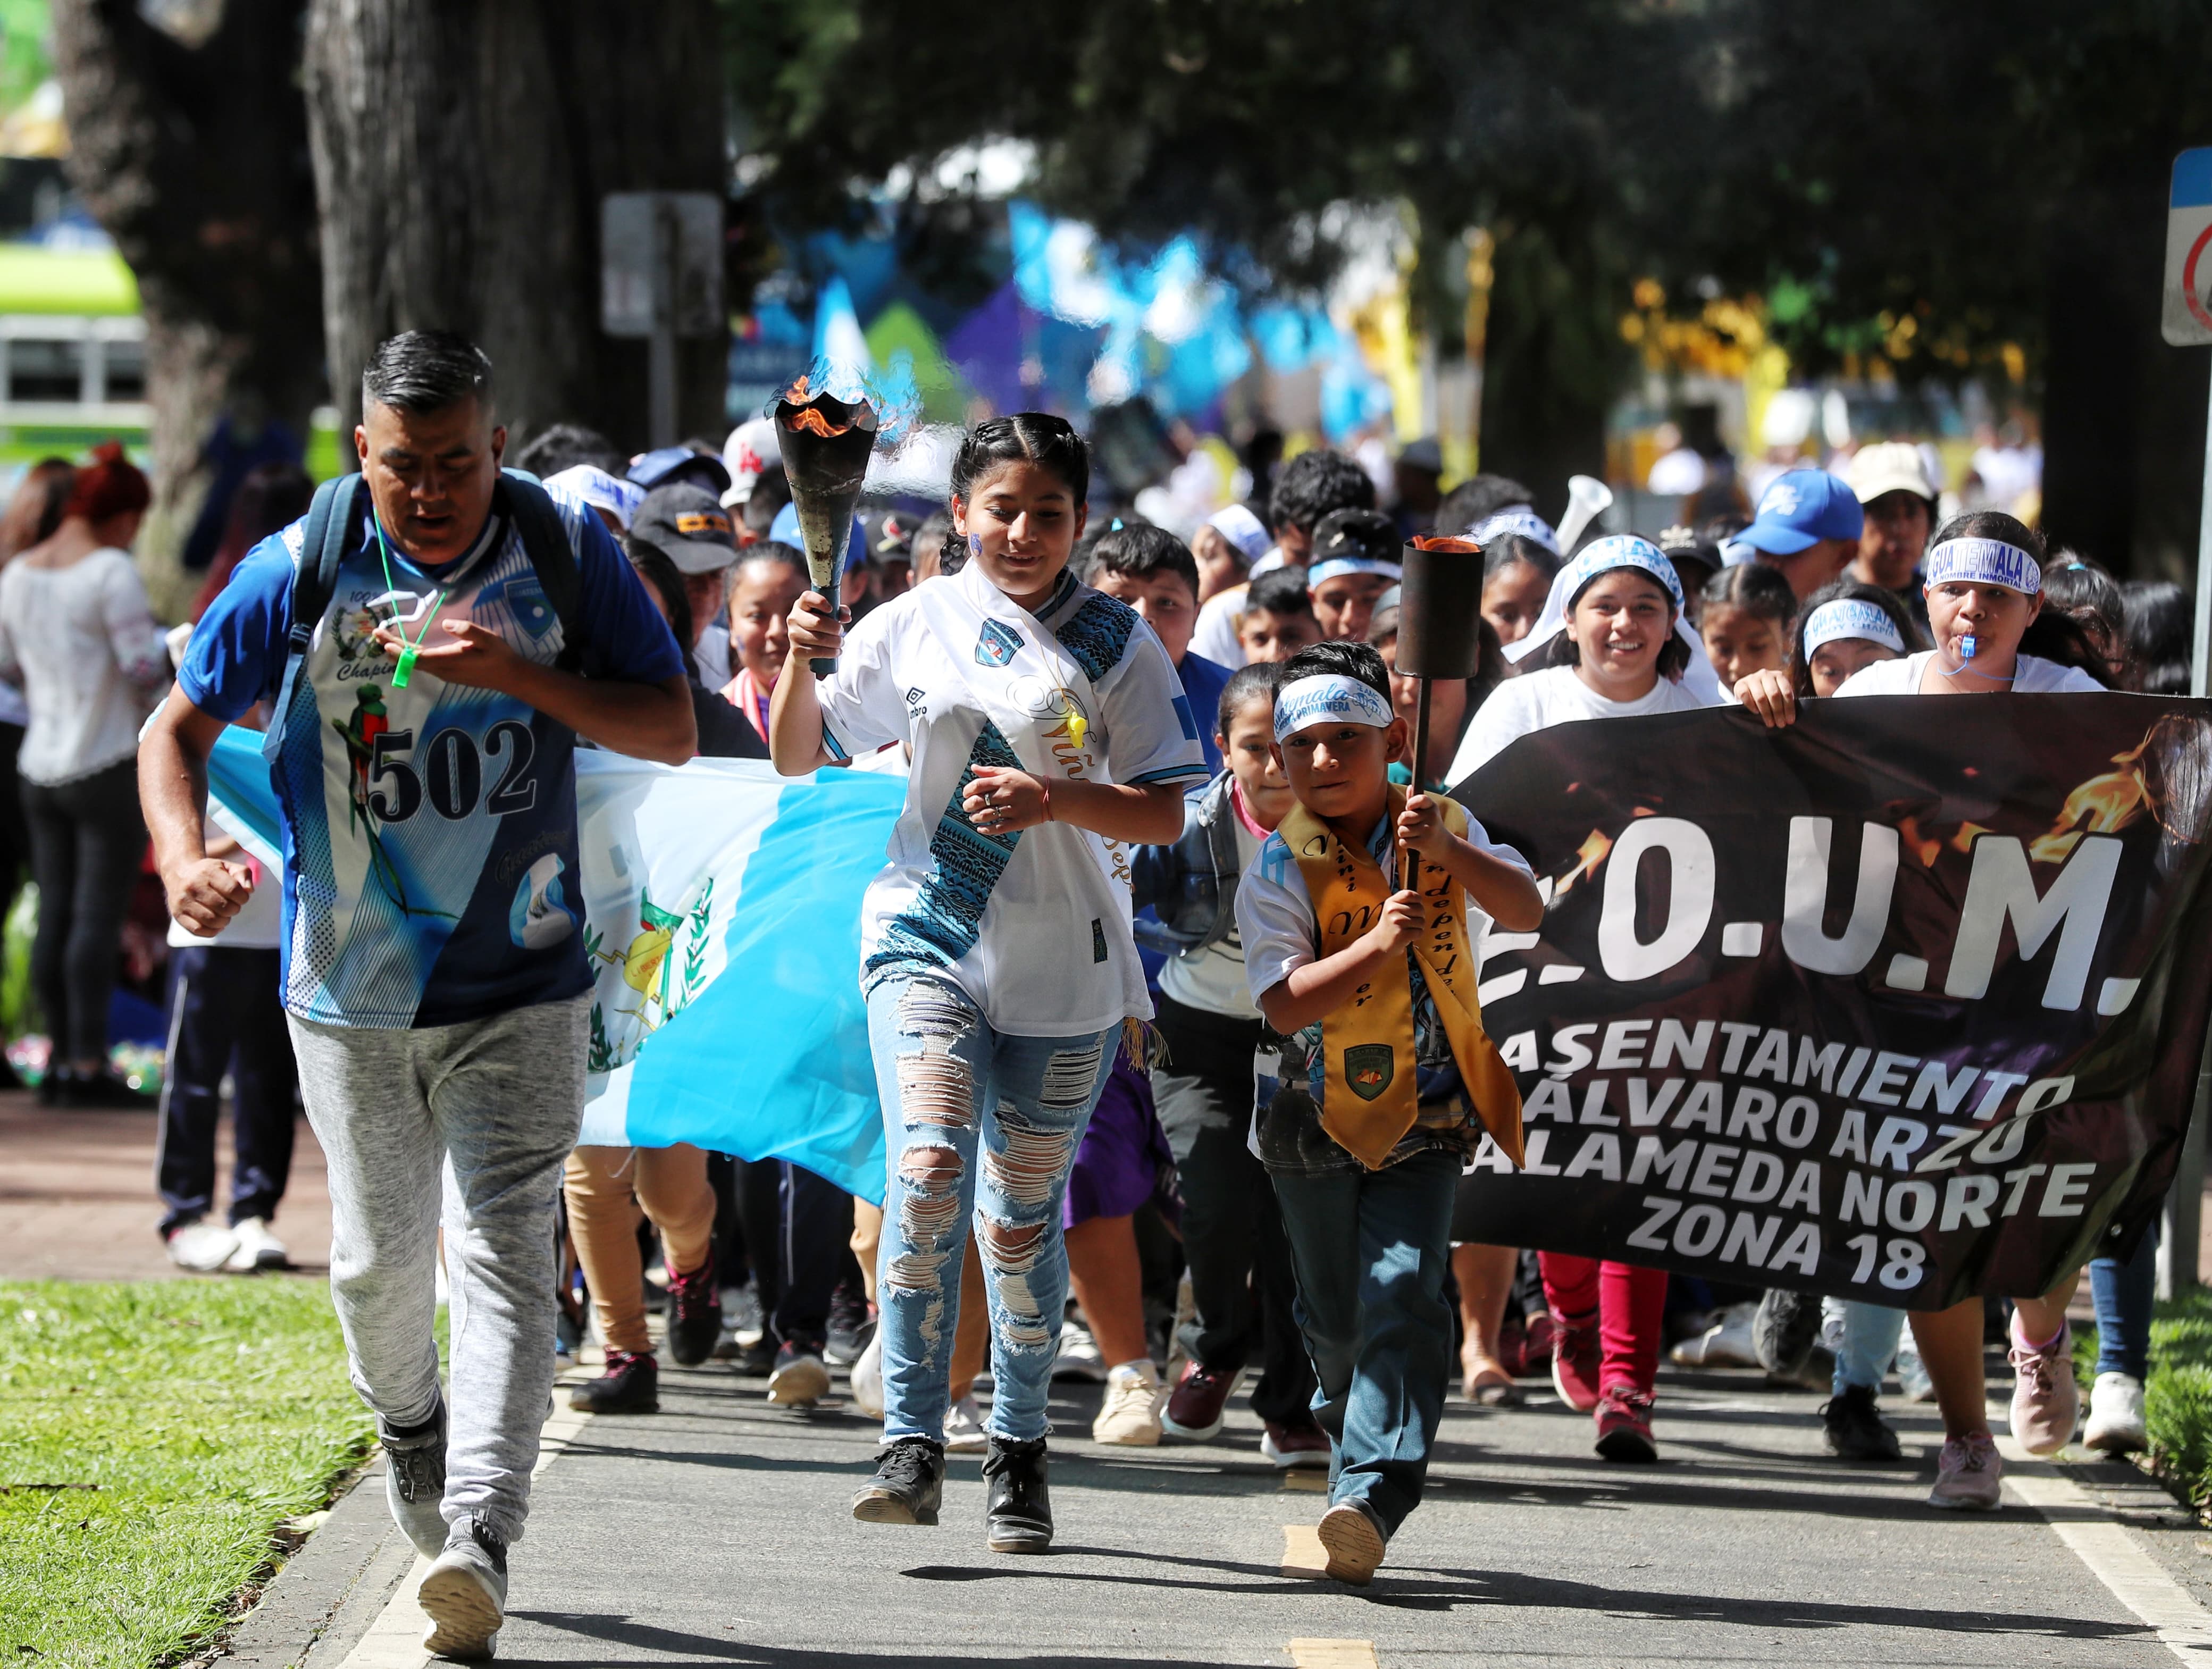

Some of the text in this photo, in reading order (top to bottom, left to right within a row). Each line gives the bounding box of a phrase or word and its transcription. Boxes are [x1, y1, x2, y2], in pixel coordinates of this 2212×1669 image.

[1932, 542, 2023, 580] GUATEMALA
[1940, 571, 1976, 582] NOMBRE
[1979, 571, 2022, 589] INMORTAL
[1813, 603, 1895, 636] GUATEMALA
[909, 706, 927, 719] mbro
[1296, 699, 1351, 719] PRIMAVERA
[368, 720, 537, 824] 502
[1499, 1018, 2075, 1122] ASENTAMIENTO
[1522, 1072, 1820, 1148] ÁLVARO
[1462, 1129, 2097, 1232] ALAMEDA NORTE
[1626, 1195, 1926, 1290] ZONA 18
